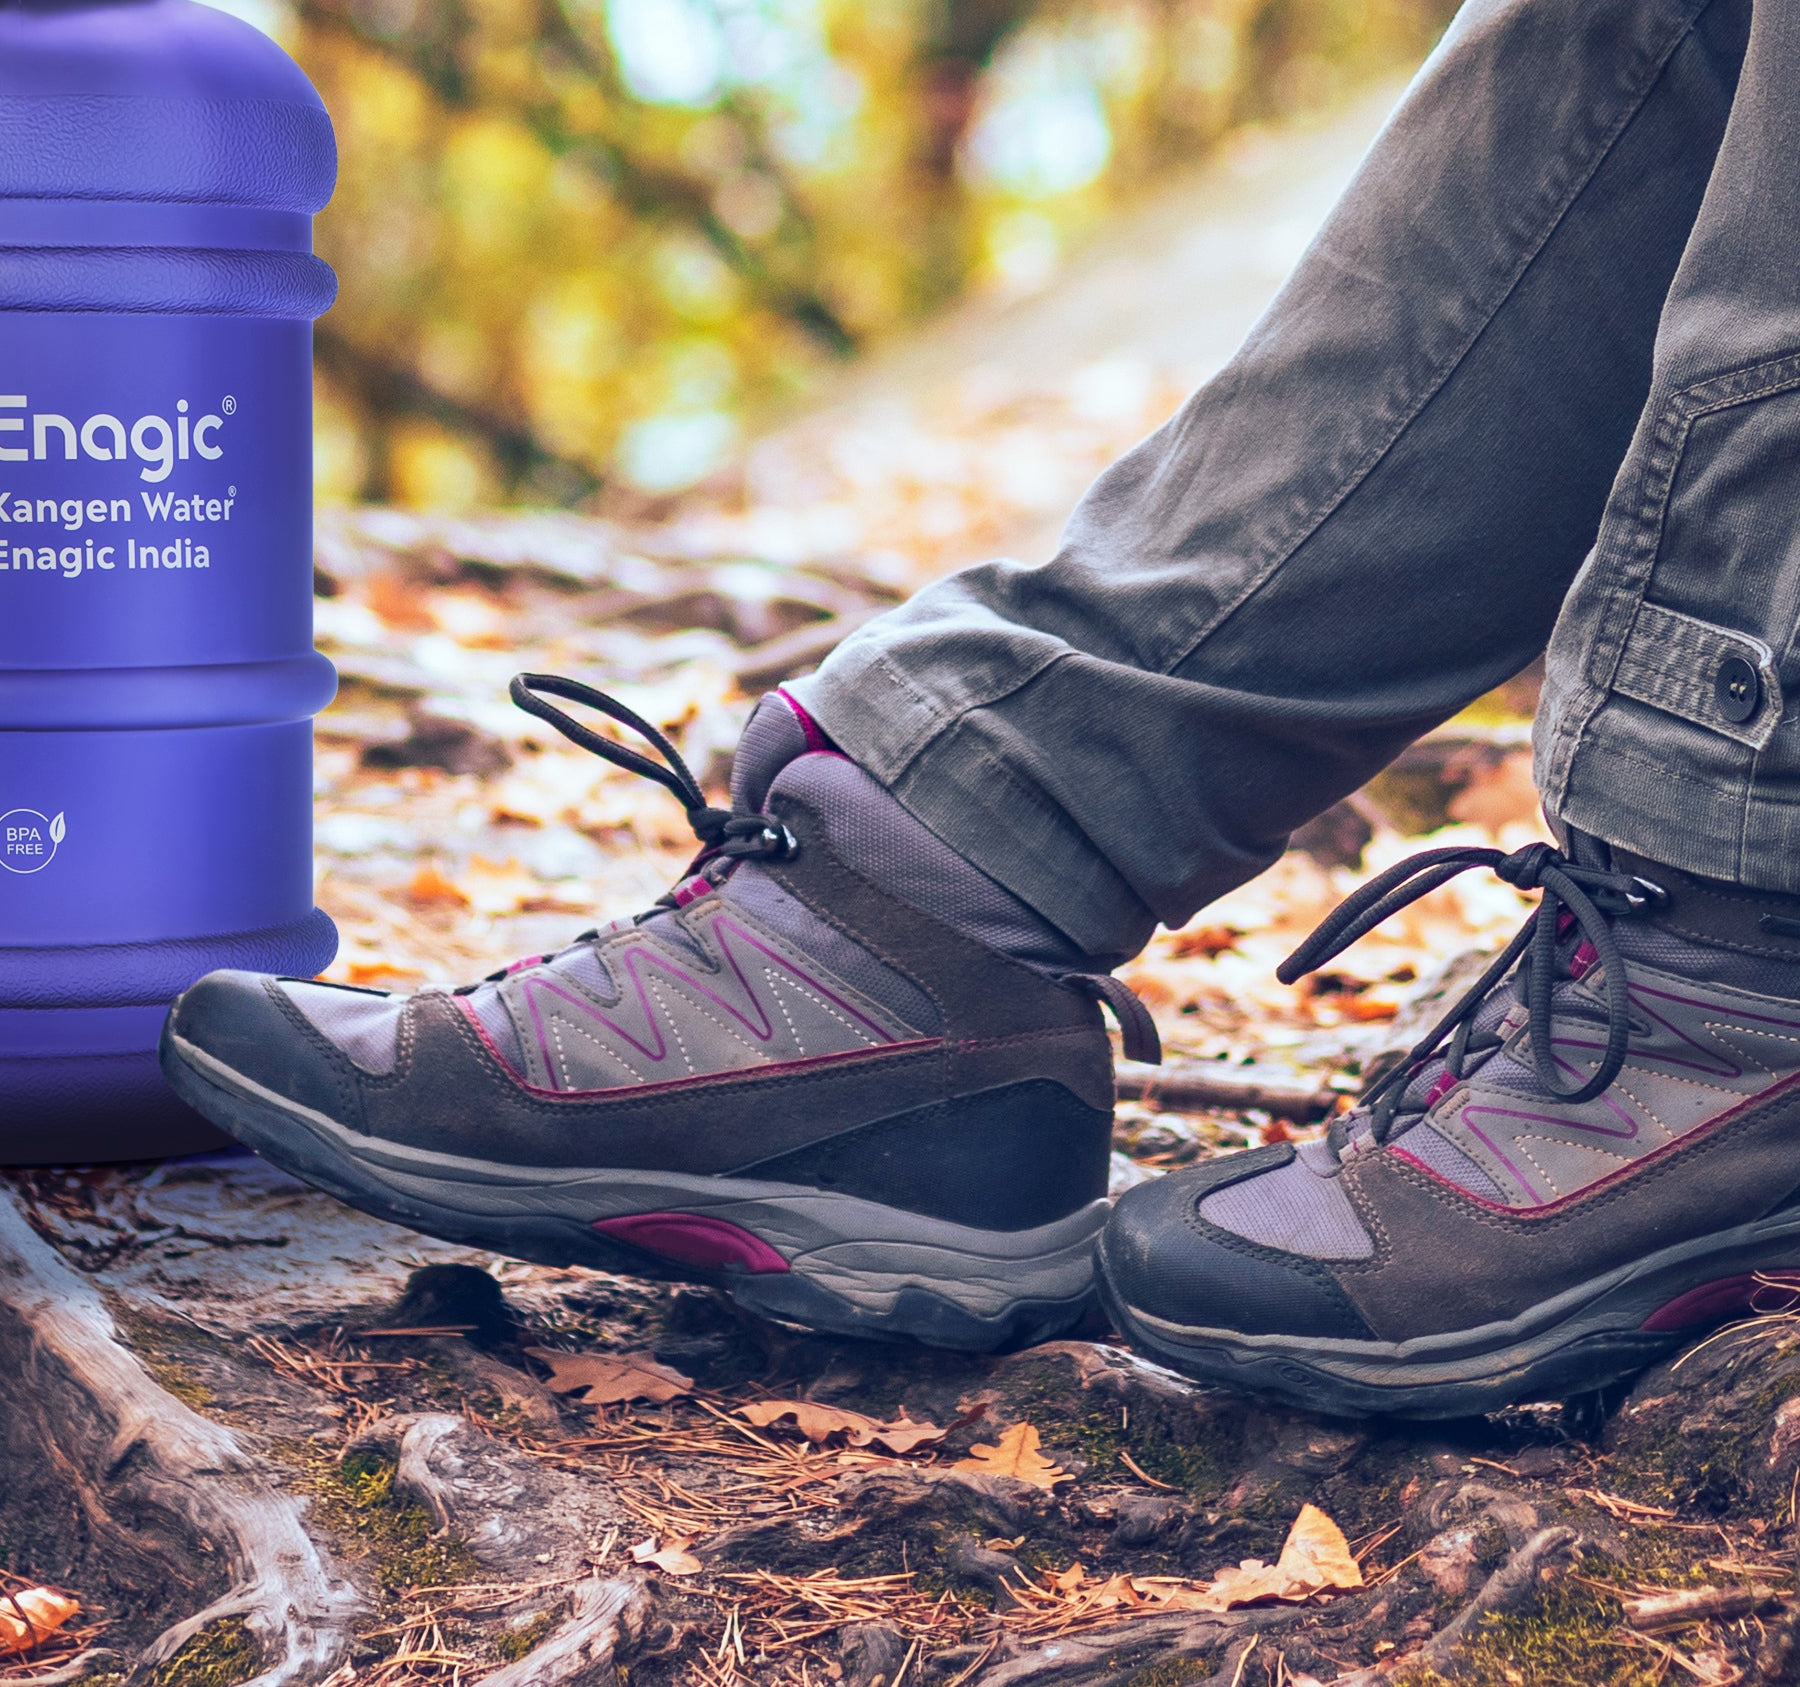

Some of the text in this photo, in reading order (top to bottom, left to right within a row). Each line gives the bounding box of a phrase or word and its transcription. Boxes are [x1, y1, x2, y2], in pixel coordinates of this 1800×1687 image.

[127, 537, 211, 570] India
[6, 827, 41, 842] BPA
[7, 843, 44, 855] FREE
